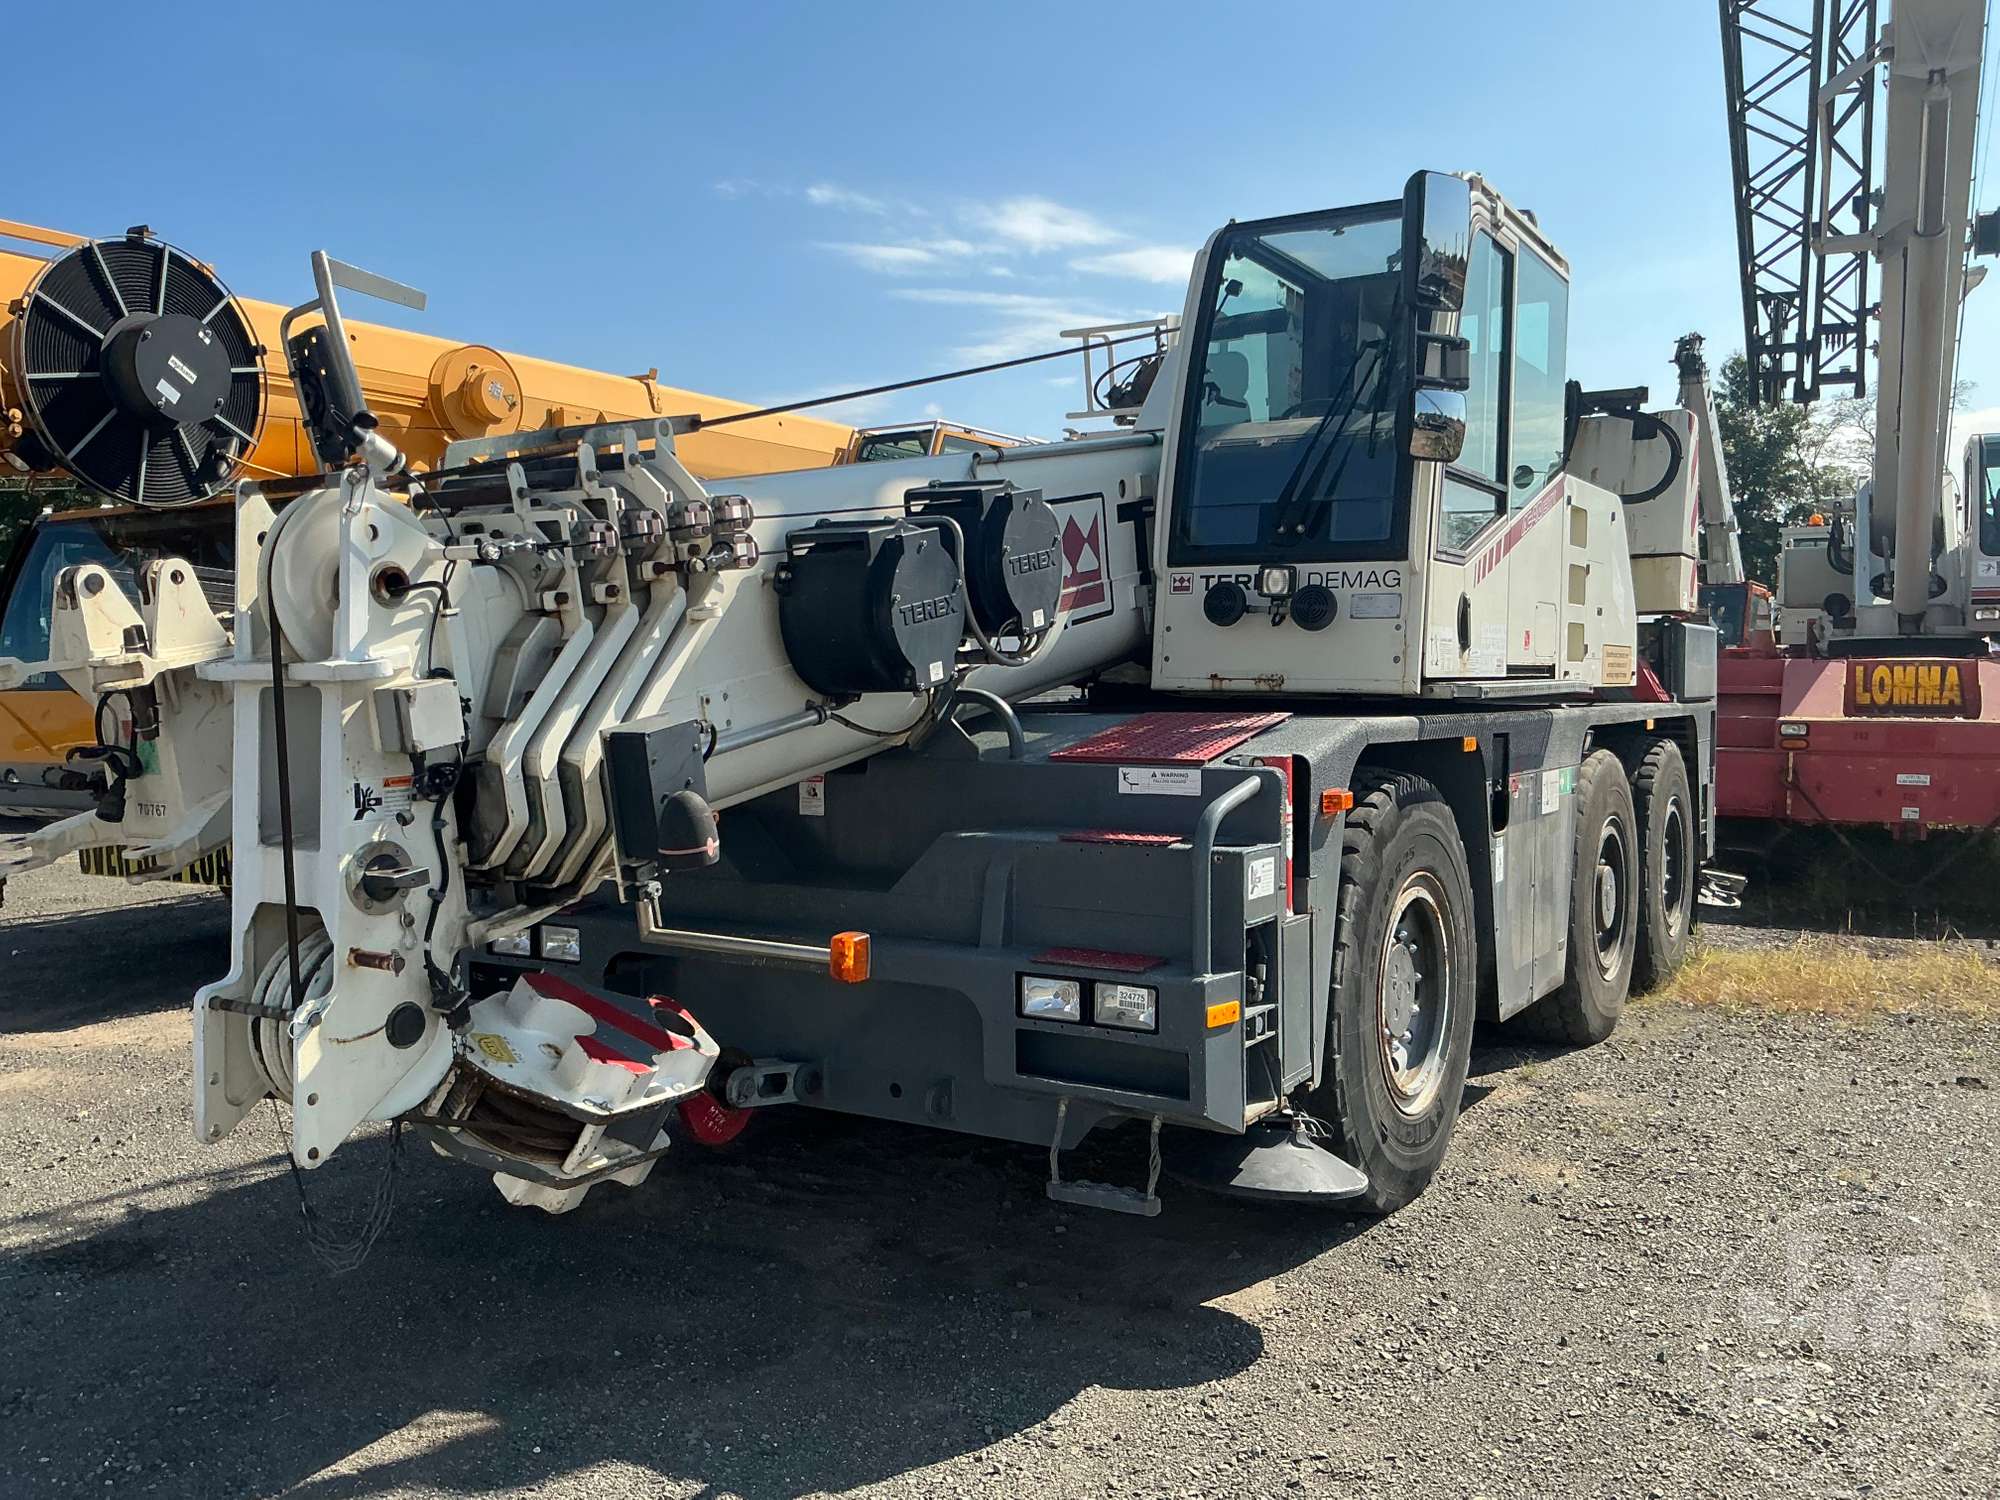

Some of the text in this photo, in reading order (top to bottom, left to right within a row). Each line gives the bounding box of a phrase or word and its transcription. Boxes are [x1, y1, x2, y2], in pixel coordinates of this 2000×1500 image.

[1009, 548, 1056, 575] TEREX
[1307, 570, 1401, 589] DEMAG
[900, 593, 958, 625] TEREX
[1855, 664, 1962, 706] LOMMA
[1119, 991, 1146, 1002] 324775
